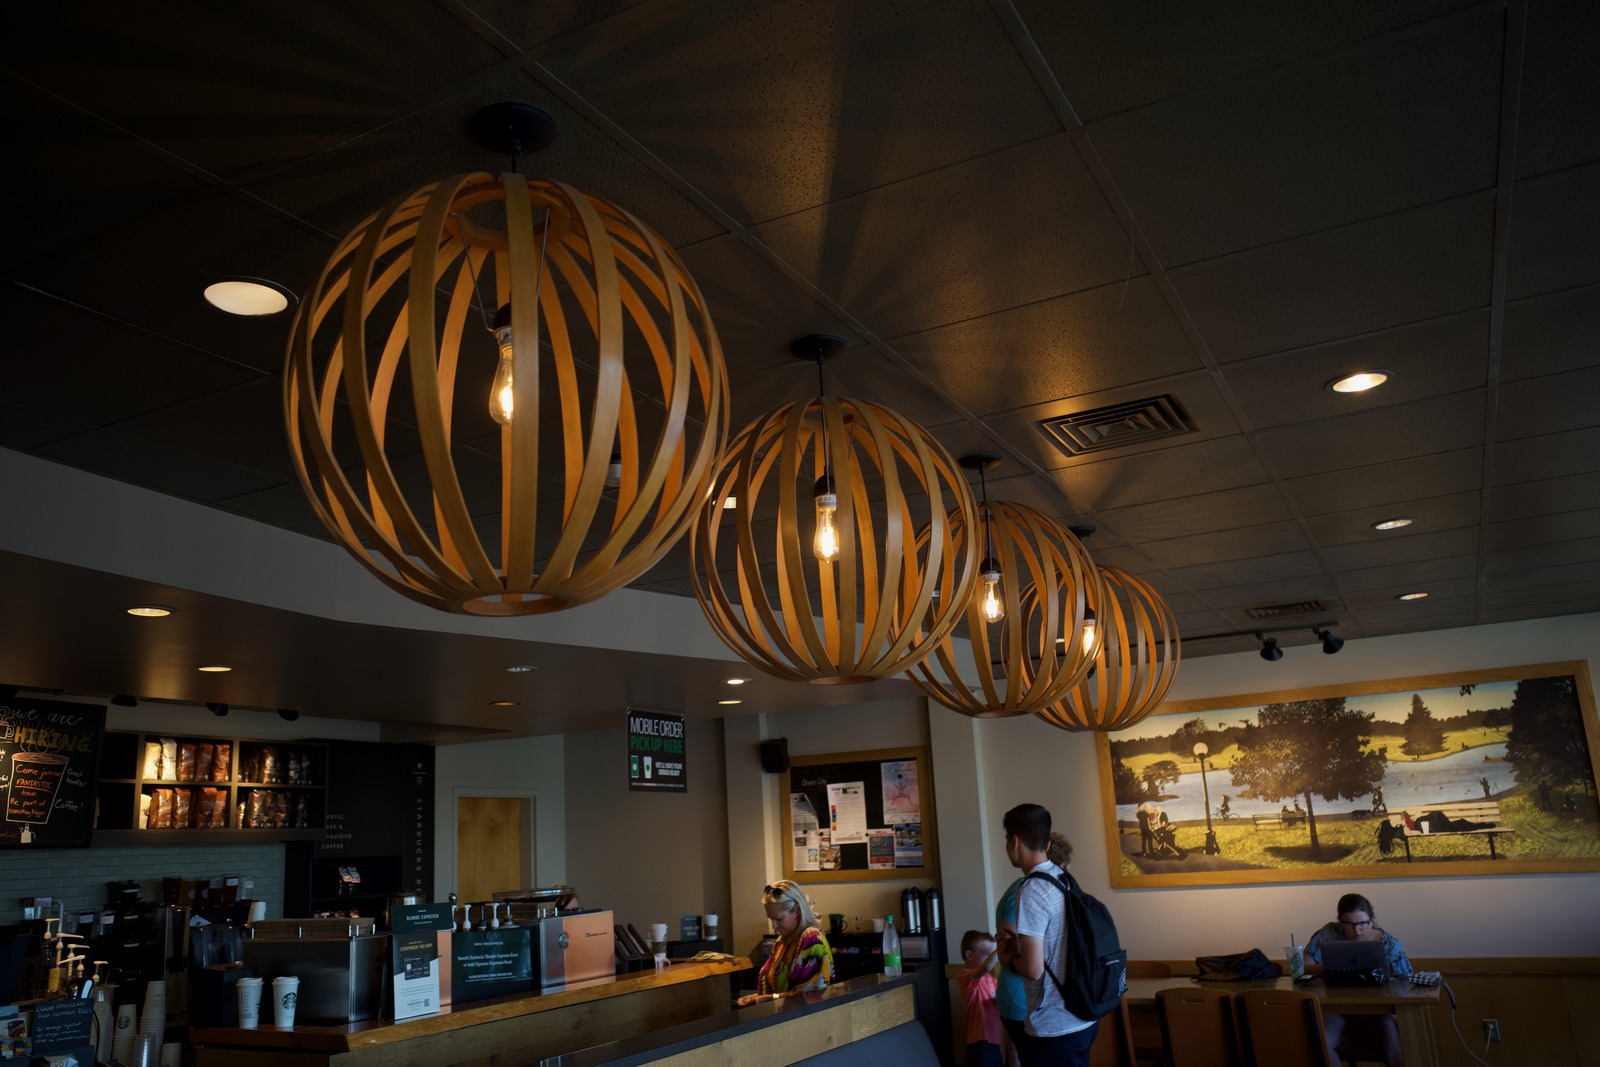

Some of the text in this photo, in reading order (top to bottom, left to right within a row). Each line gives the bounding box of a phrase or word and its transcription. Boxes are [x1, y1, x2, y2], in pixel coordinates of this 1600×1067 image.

[48, 713, 84, 726] are
[630, 716, 683, 738] MOBILE ORDER
[14, 725, 93, 753] HIRING
[630, 735, 683, 754] PICK UP HERE
[15, 764, 39, 776] Come
[670, 769, 681, 777] READY
[16, 778, 53, 790] FANTASTIC
[10, 797, 20, 806] Be
[23, 800, 38, 808] part
[415, 798, 424, 872] STARBUCKS
